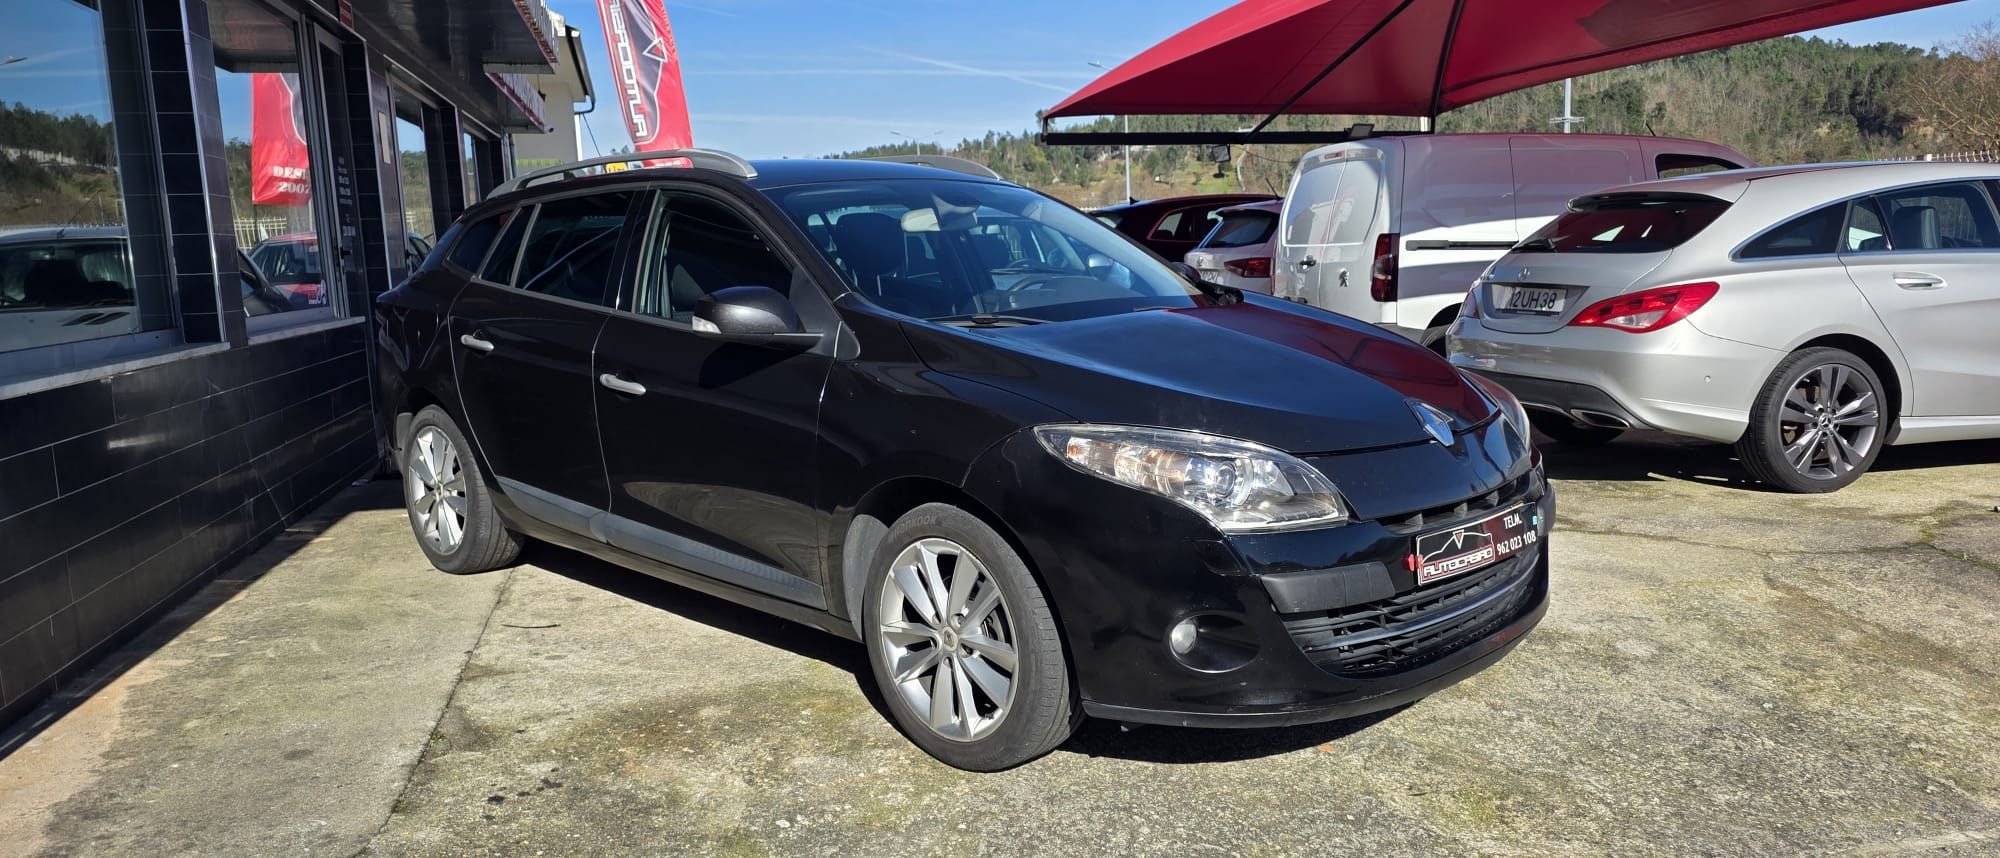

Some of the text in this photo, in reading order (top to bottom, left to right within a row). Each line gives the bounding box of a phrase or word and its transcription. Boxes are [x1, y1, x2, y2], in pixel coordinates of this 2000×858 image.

[1496, 530, 1536, 556] 962 023 108
